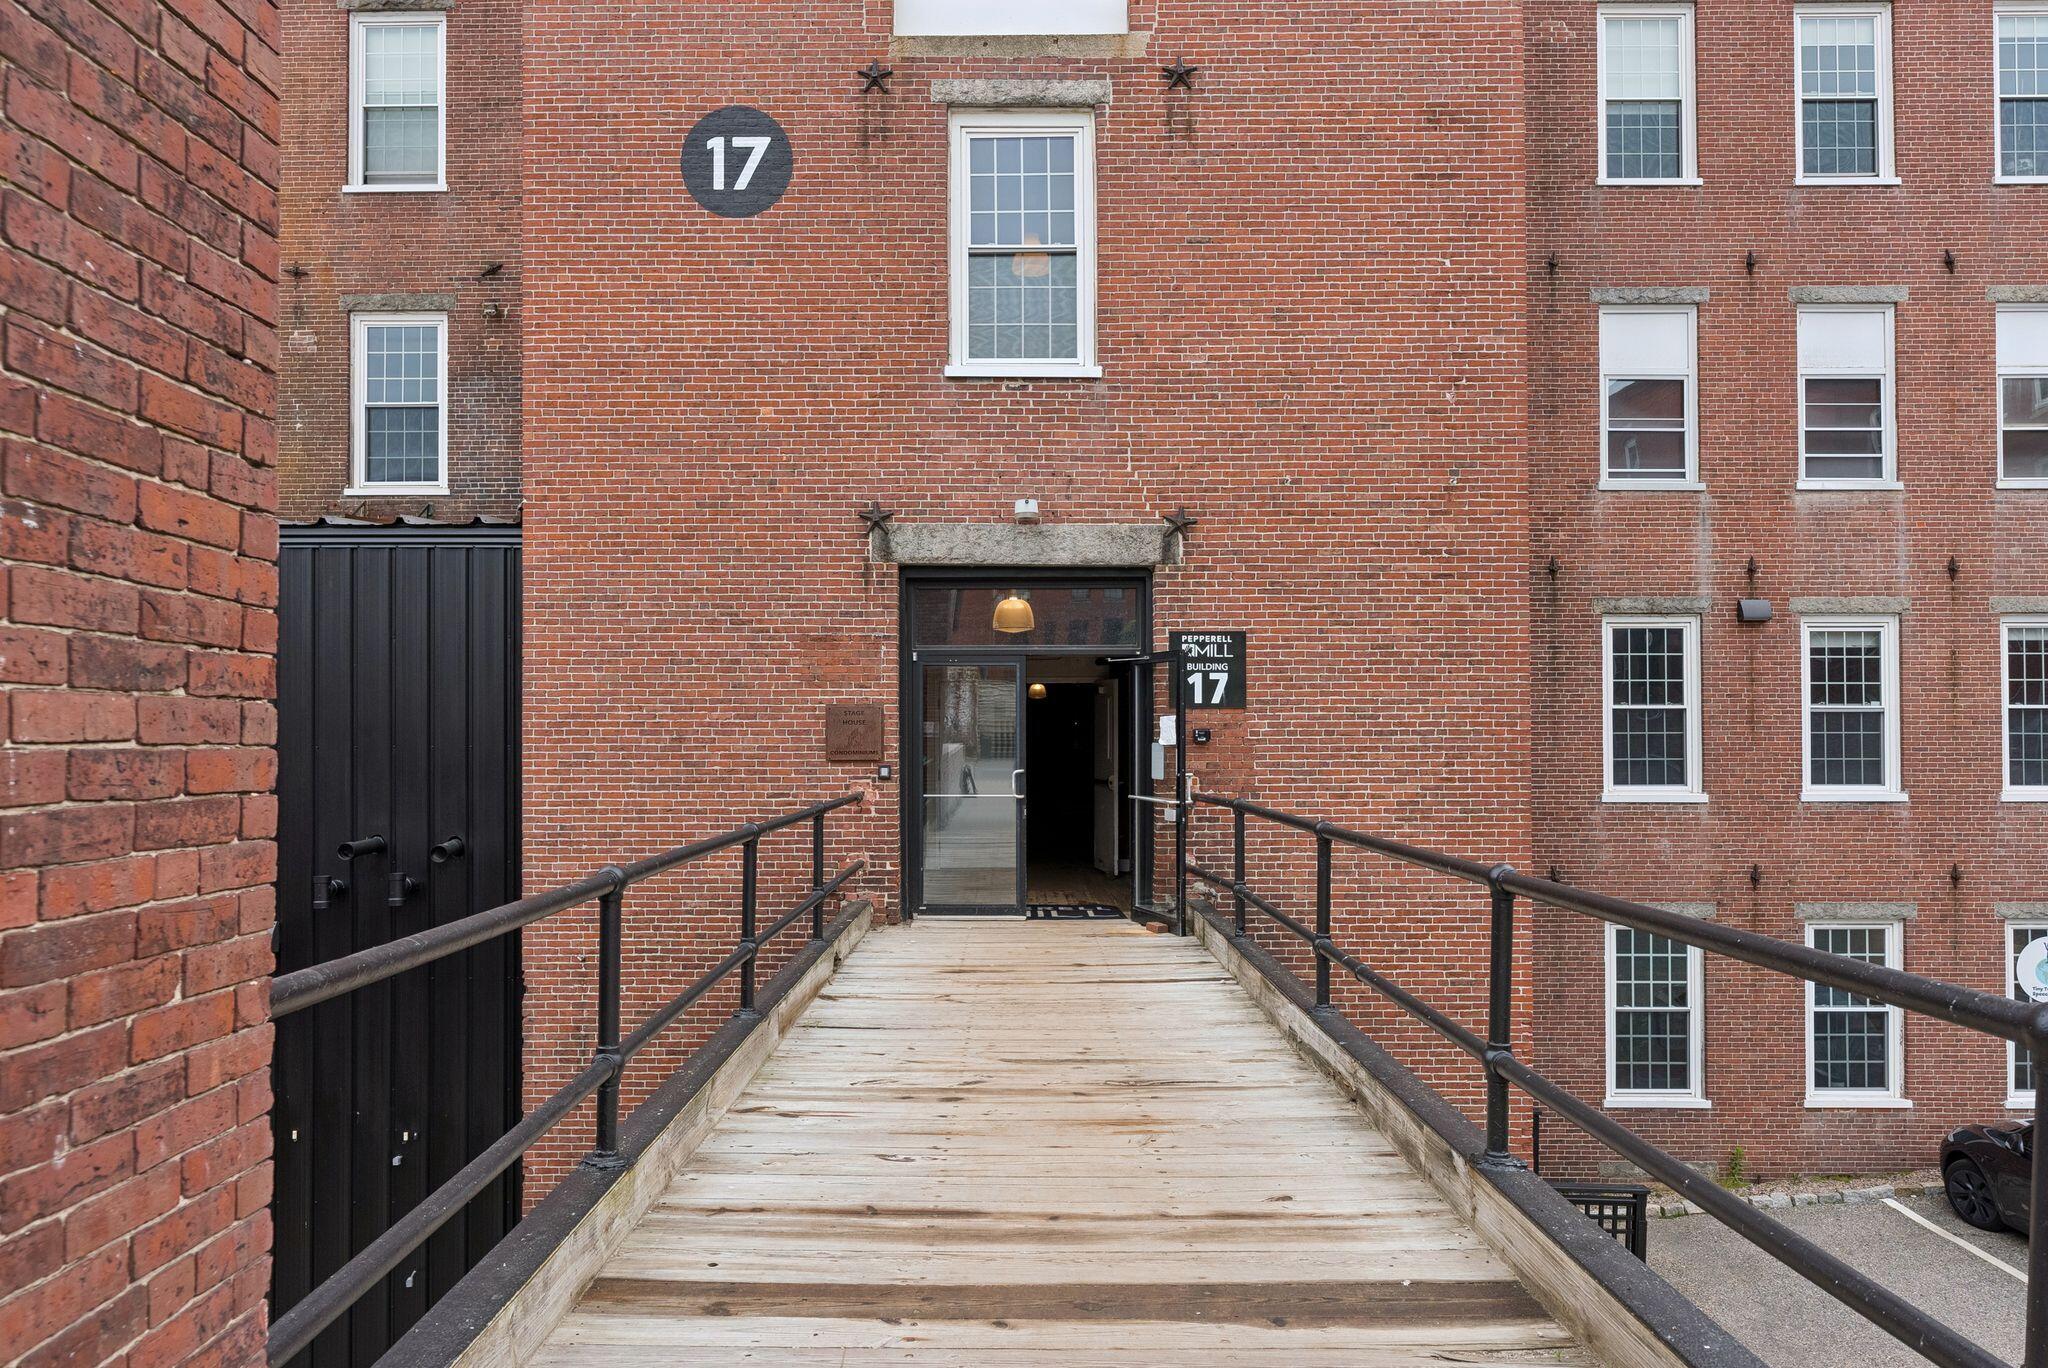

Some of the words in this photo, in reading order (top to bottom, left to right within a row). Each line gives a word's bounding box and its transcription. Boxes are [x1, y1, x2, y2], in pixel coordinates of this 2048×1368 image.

[706, 136, 772, 191] 17
[1181, 635, 1233, 643] PEPPERELL
[1195, 643, 1234, 658] MILL
[1186, 662, 1229, 671] BUILDING
[1187, 672, 1229, 704] 17
